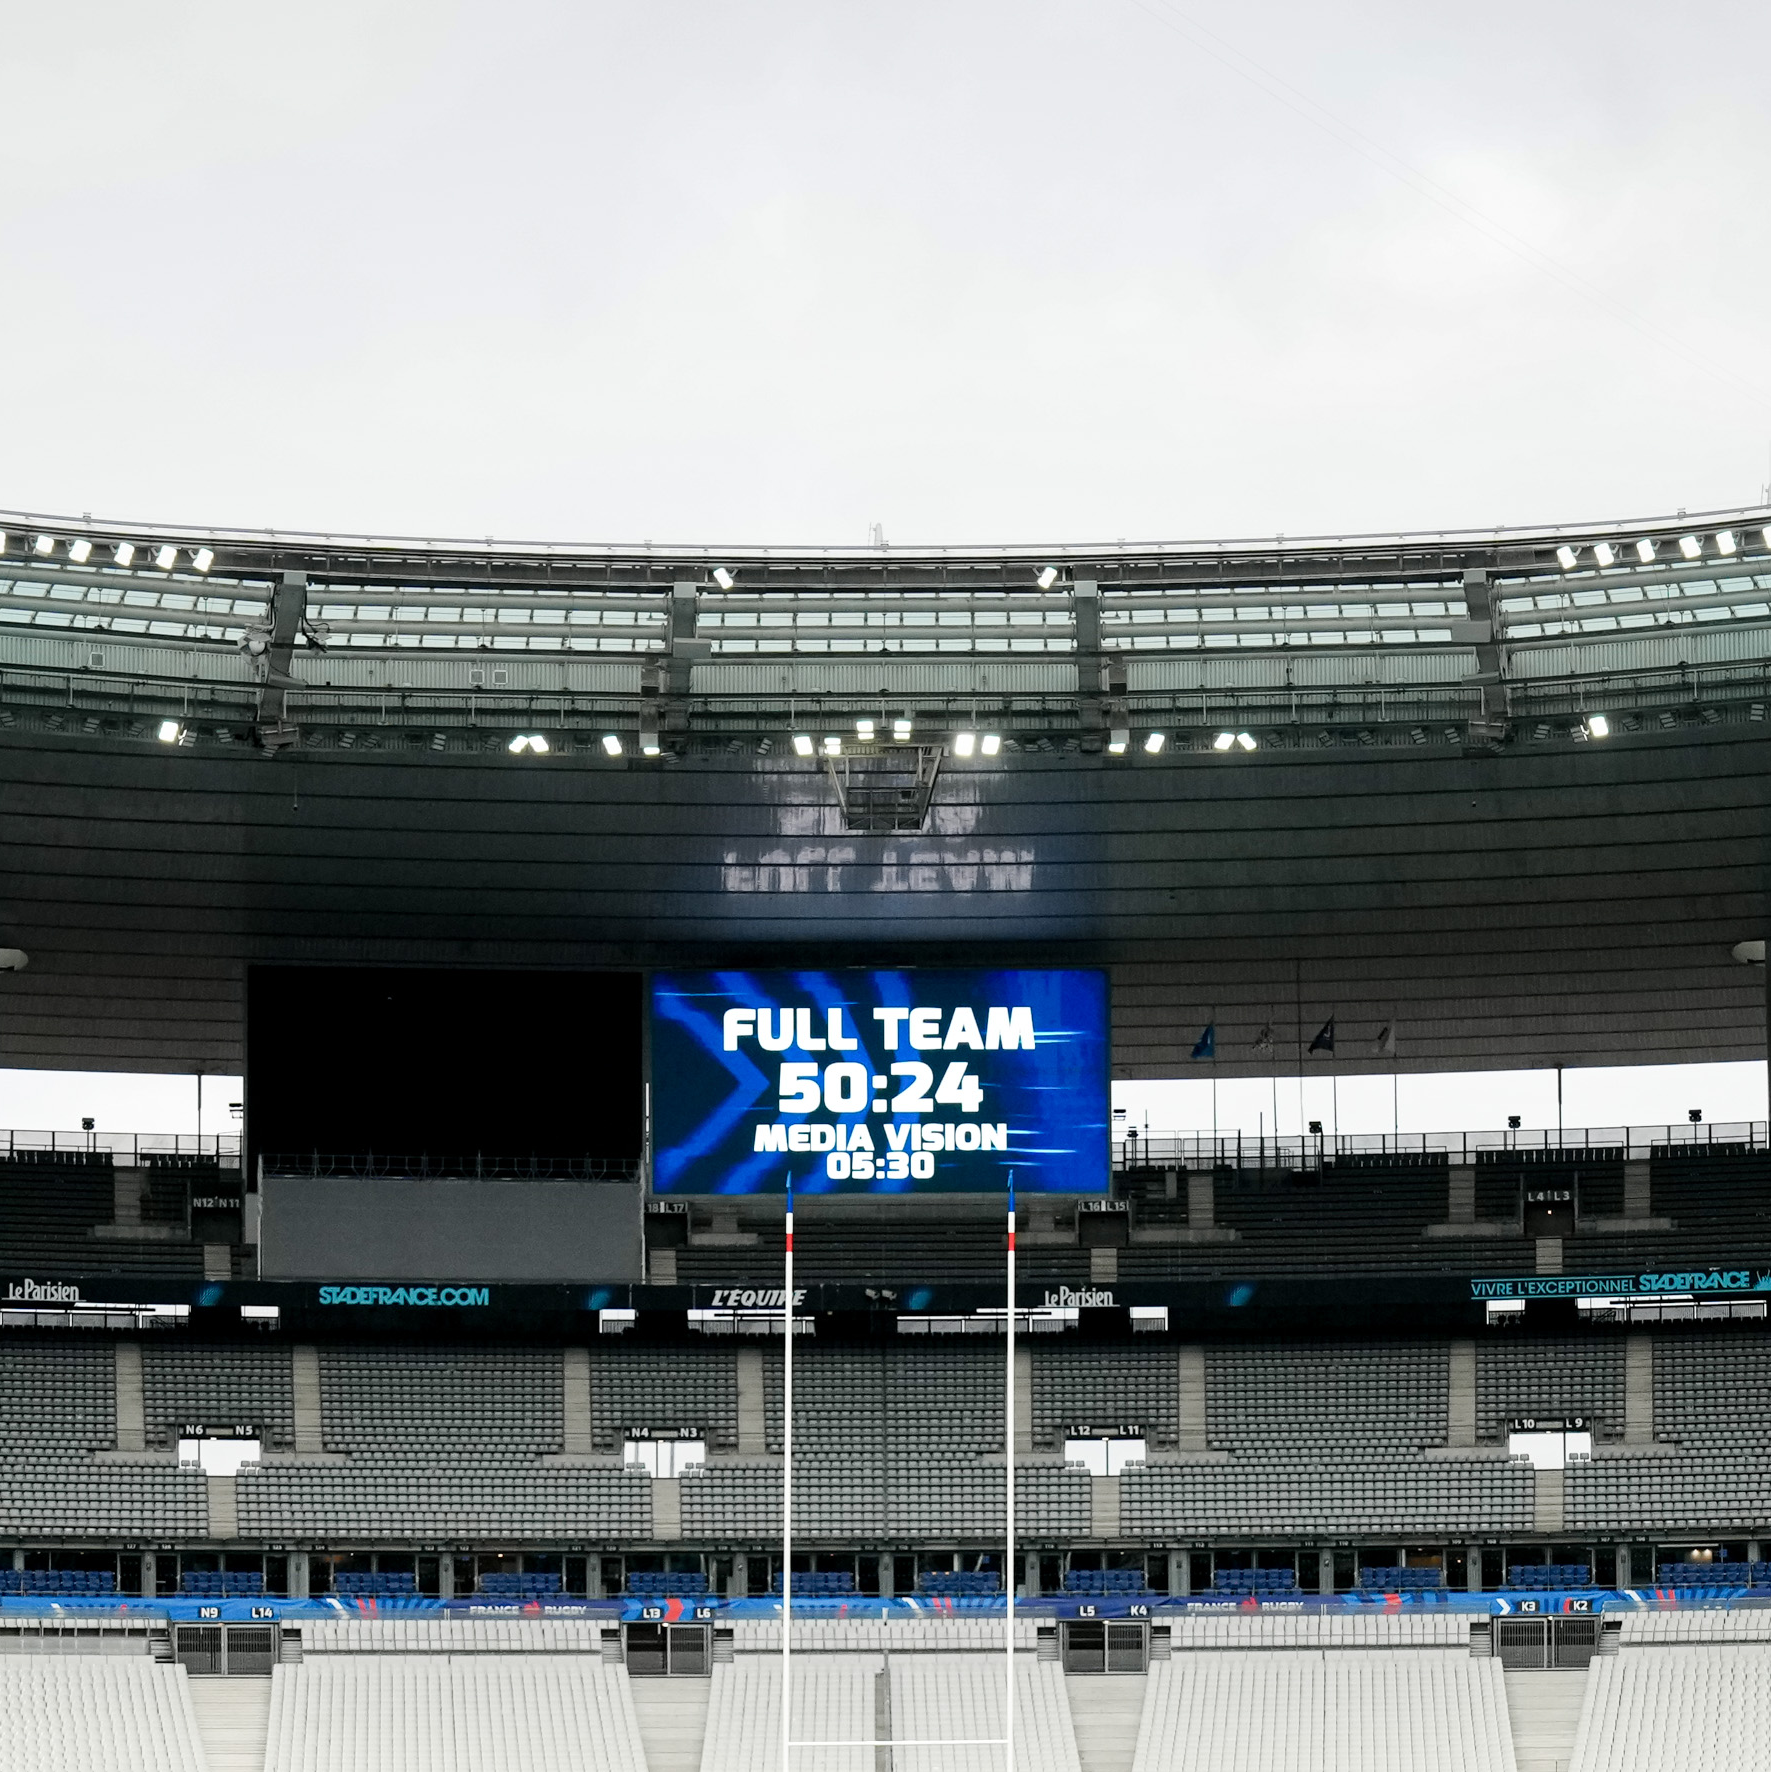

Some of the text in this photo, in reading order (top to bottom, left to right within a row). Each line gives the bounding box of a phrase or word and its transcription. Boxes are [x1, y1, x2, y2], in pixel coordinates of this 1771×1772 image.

[724, 1007, 1035, 1051] FULL TEAM
[779, 1061, 983, 1113] 50:24
[754, 1123, 1007, 1153] MEDIA VISION
[827, 1152, 934, 1179] 05:30
[8, 1278, 81, 1300] Le Parisien
[319, 1287, 488, 1305] STADEFRANCE.COM
[1044, 1286, 1115, 1307] Le Parisien
[1471, 1283, 1513, 1296] VIVRE
[1518, 1280, 1636, 1294] L'EXCEPTIONNEL
